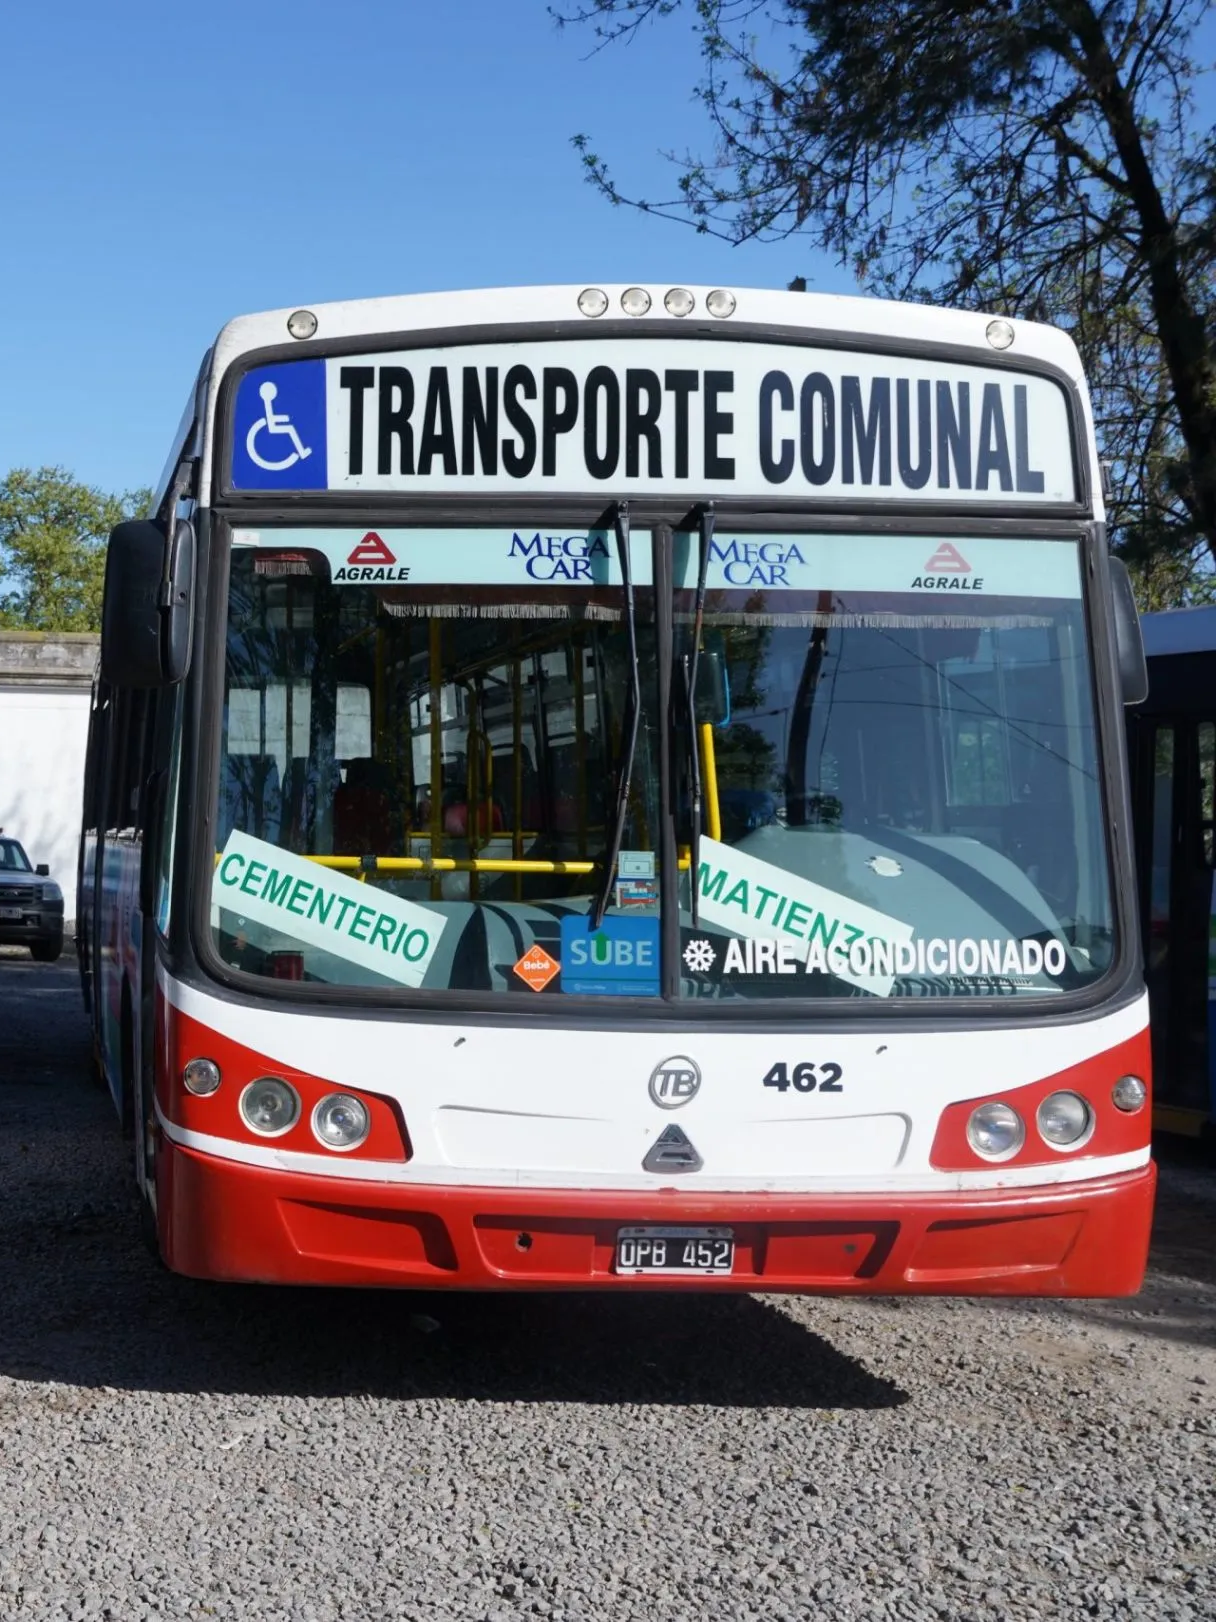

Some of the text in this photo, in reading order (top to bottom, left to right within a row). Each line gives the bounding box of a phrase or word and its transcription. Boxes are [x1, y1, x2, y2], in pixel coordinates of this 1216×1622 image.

[340, 364, 1045, 493] TRANSPORTE COMUNAL
[507, 532, 612, 558] MEGA
[708, 540, 809, 565] MEGA
[334, 567, 411, 581] AGRALE
[526, 557, 596, 580] CAR
[723, 562, 792, 586] CAR
[911, 576, 984, 590] AGRALE
[219, 853, 430, 963] CEMENTERIO
[570, 939, 653, 966] SUBE
[722, 938, 1066, 976] AIRE ACONDICIONADO
[762, 1061, 844, 1093] 462
[621, 1239, 730, 1267] OPB 452
